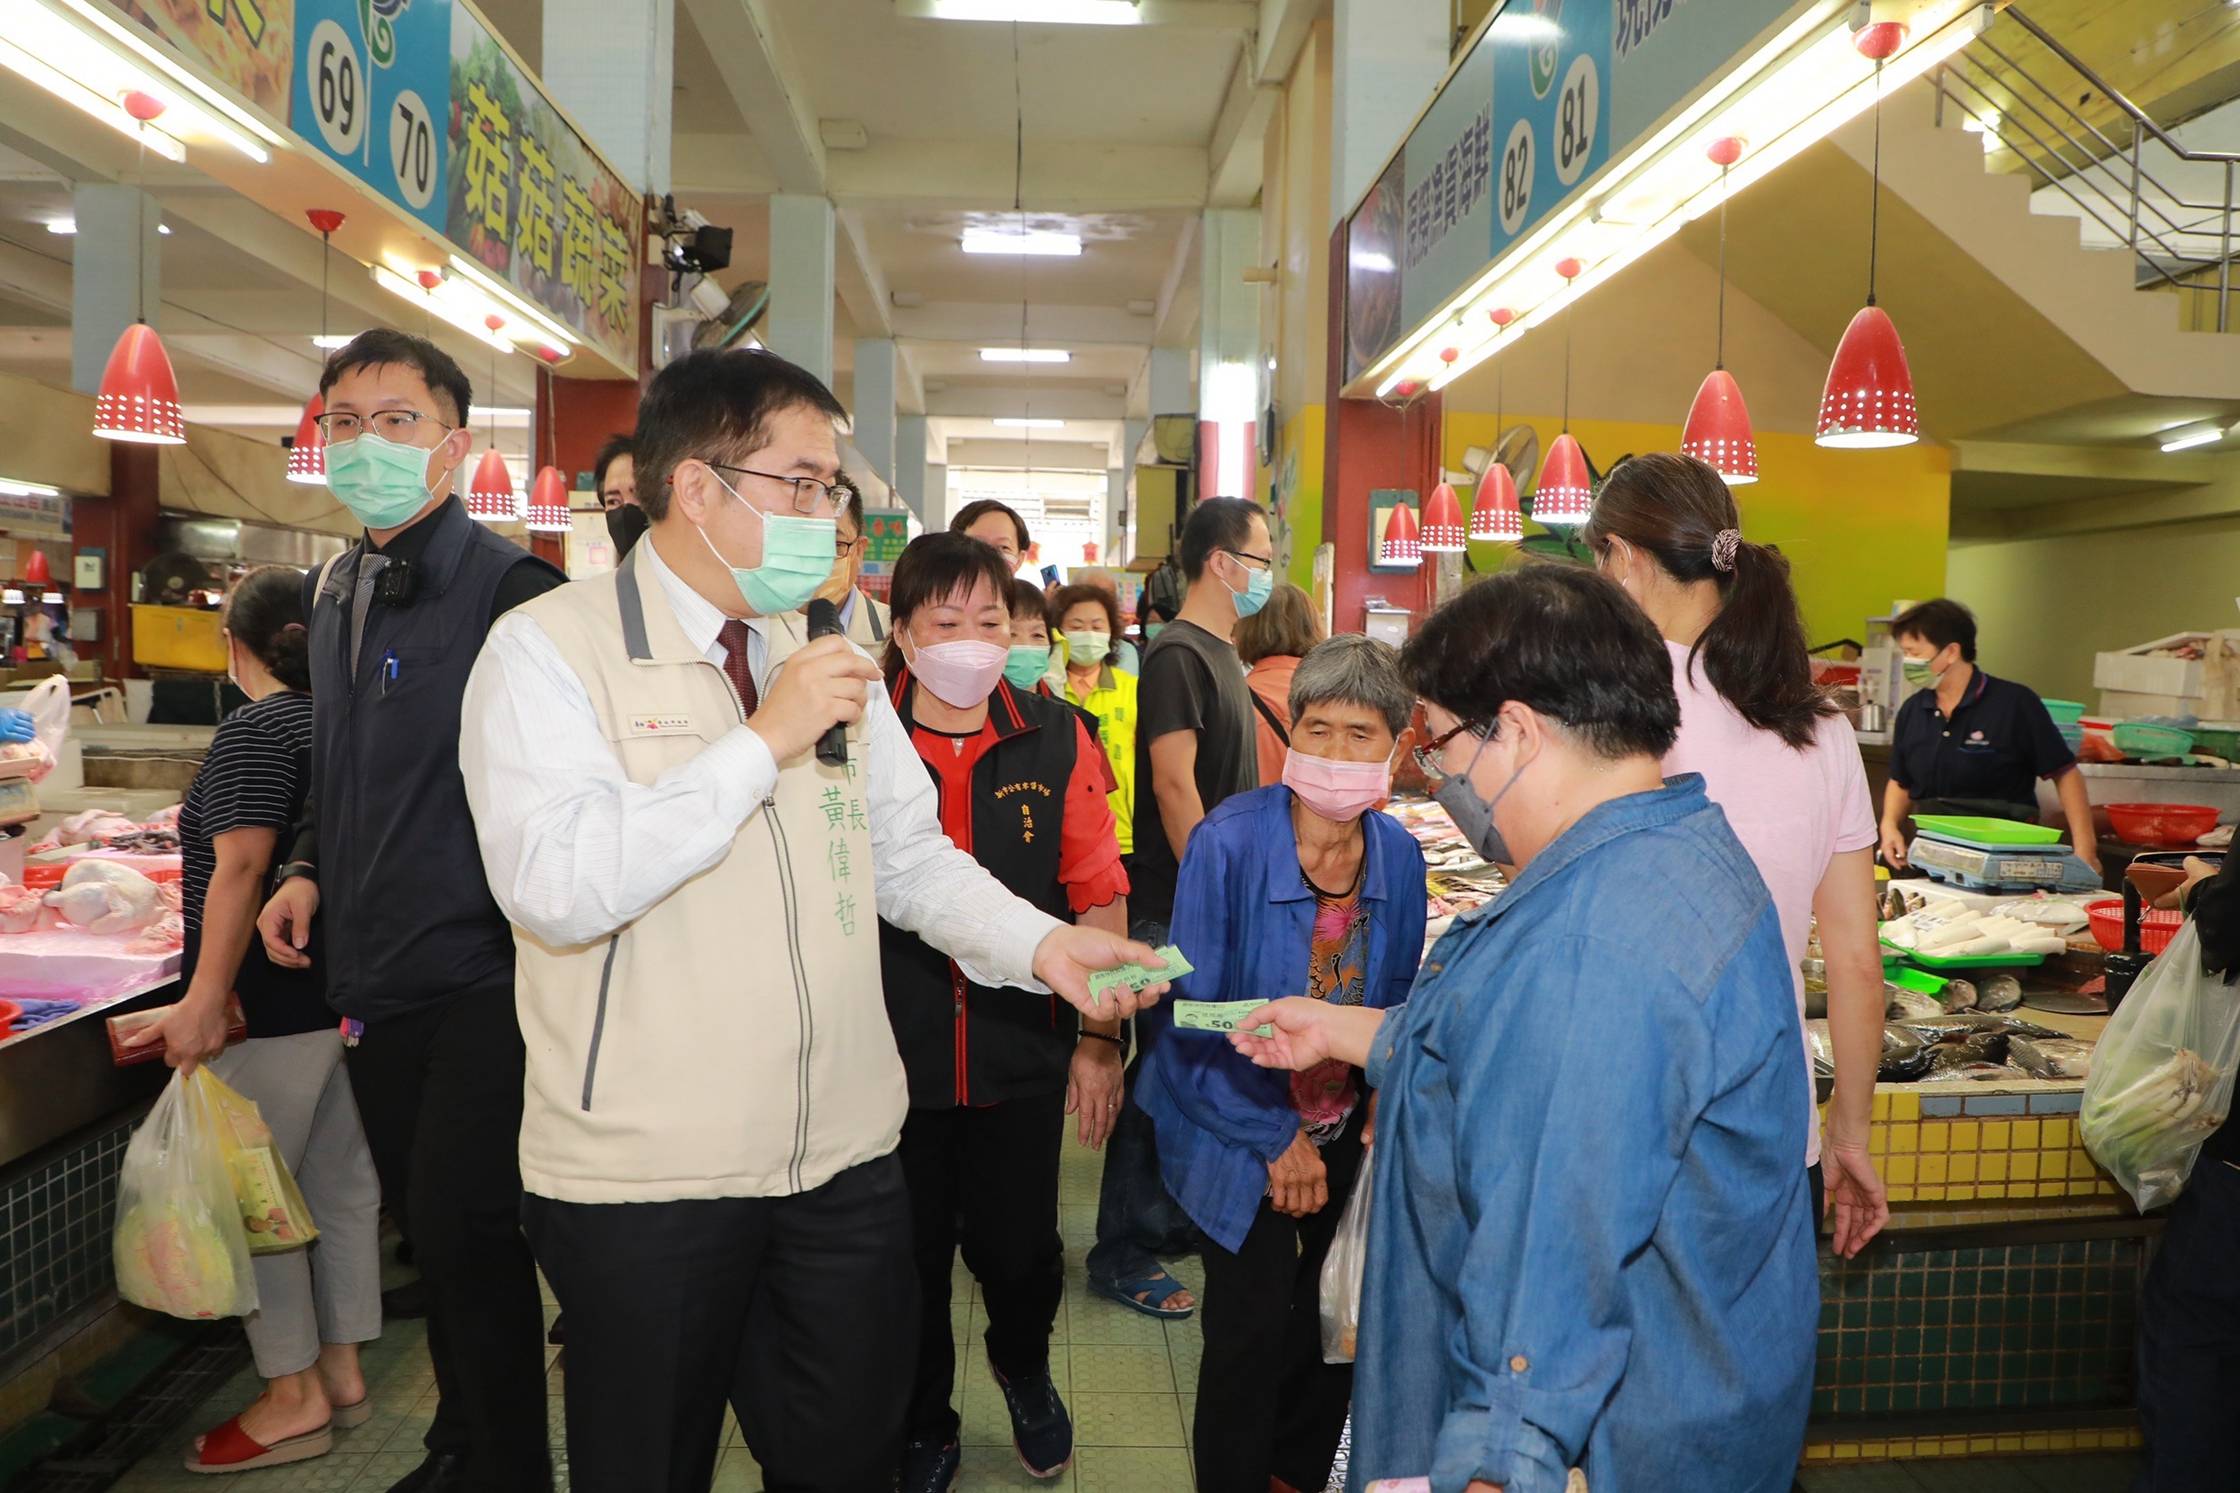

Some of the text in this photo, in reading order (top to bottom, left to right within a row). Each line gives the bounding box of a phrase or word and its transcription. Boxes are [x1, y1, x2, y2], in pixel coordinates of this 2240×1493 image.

[319, 41, 354, 136] 69
[1561, 74, 1588, 168] 81
[398, 102, 429, 192] 70
[1505, 136, 1528, 221] 82
[465, 78, 628, 334] 菇菇蔬菜
[819, 785, 857, 937] 黃偉哲
